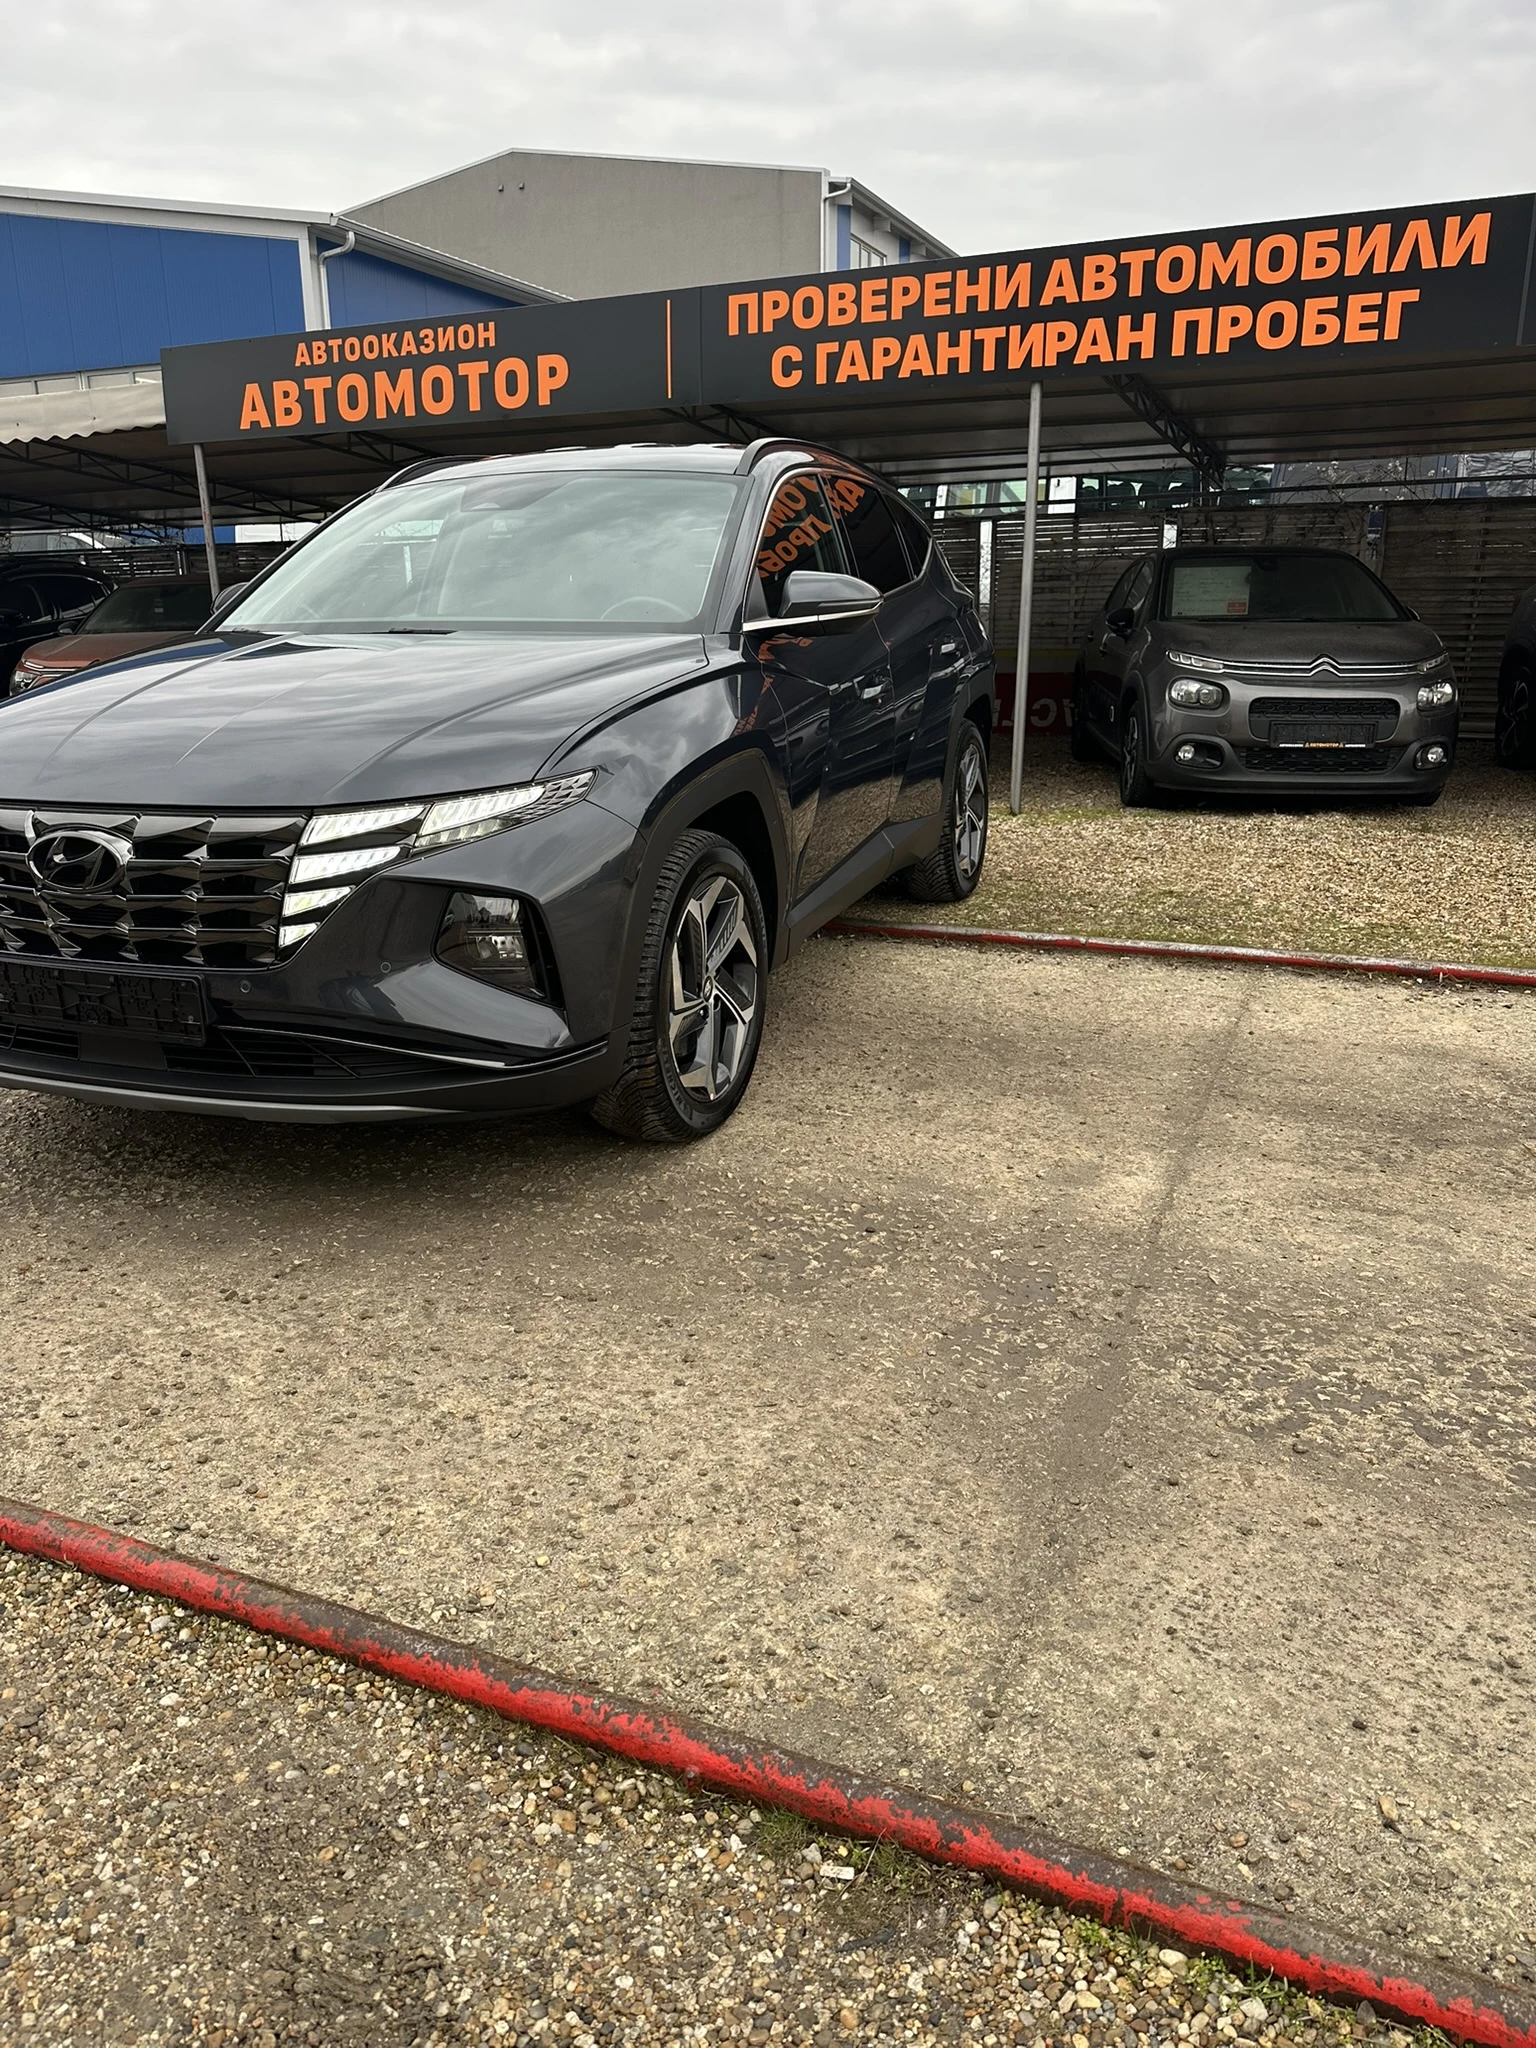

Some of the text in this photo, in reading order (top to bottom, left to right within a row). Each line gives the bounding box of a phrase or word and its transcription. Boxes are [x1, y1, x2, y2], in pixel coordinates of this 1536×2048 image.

[729, 213, 1491, 335] ПРОВЕРЕНИ АВТОМОБИЛИ
[296, 322, 495, 367] АВТООКАЗИОН
[772, 290, 1419, 387] С ГАРАНТИРАН ПРОБЕГ
[240, 355, 568, 429] АВТОМОТОР
